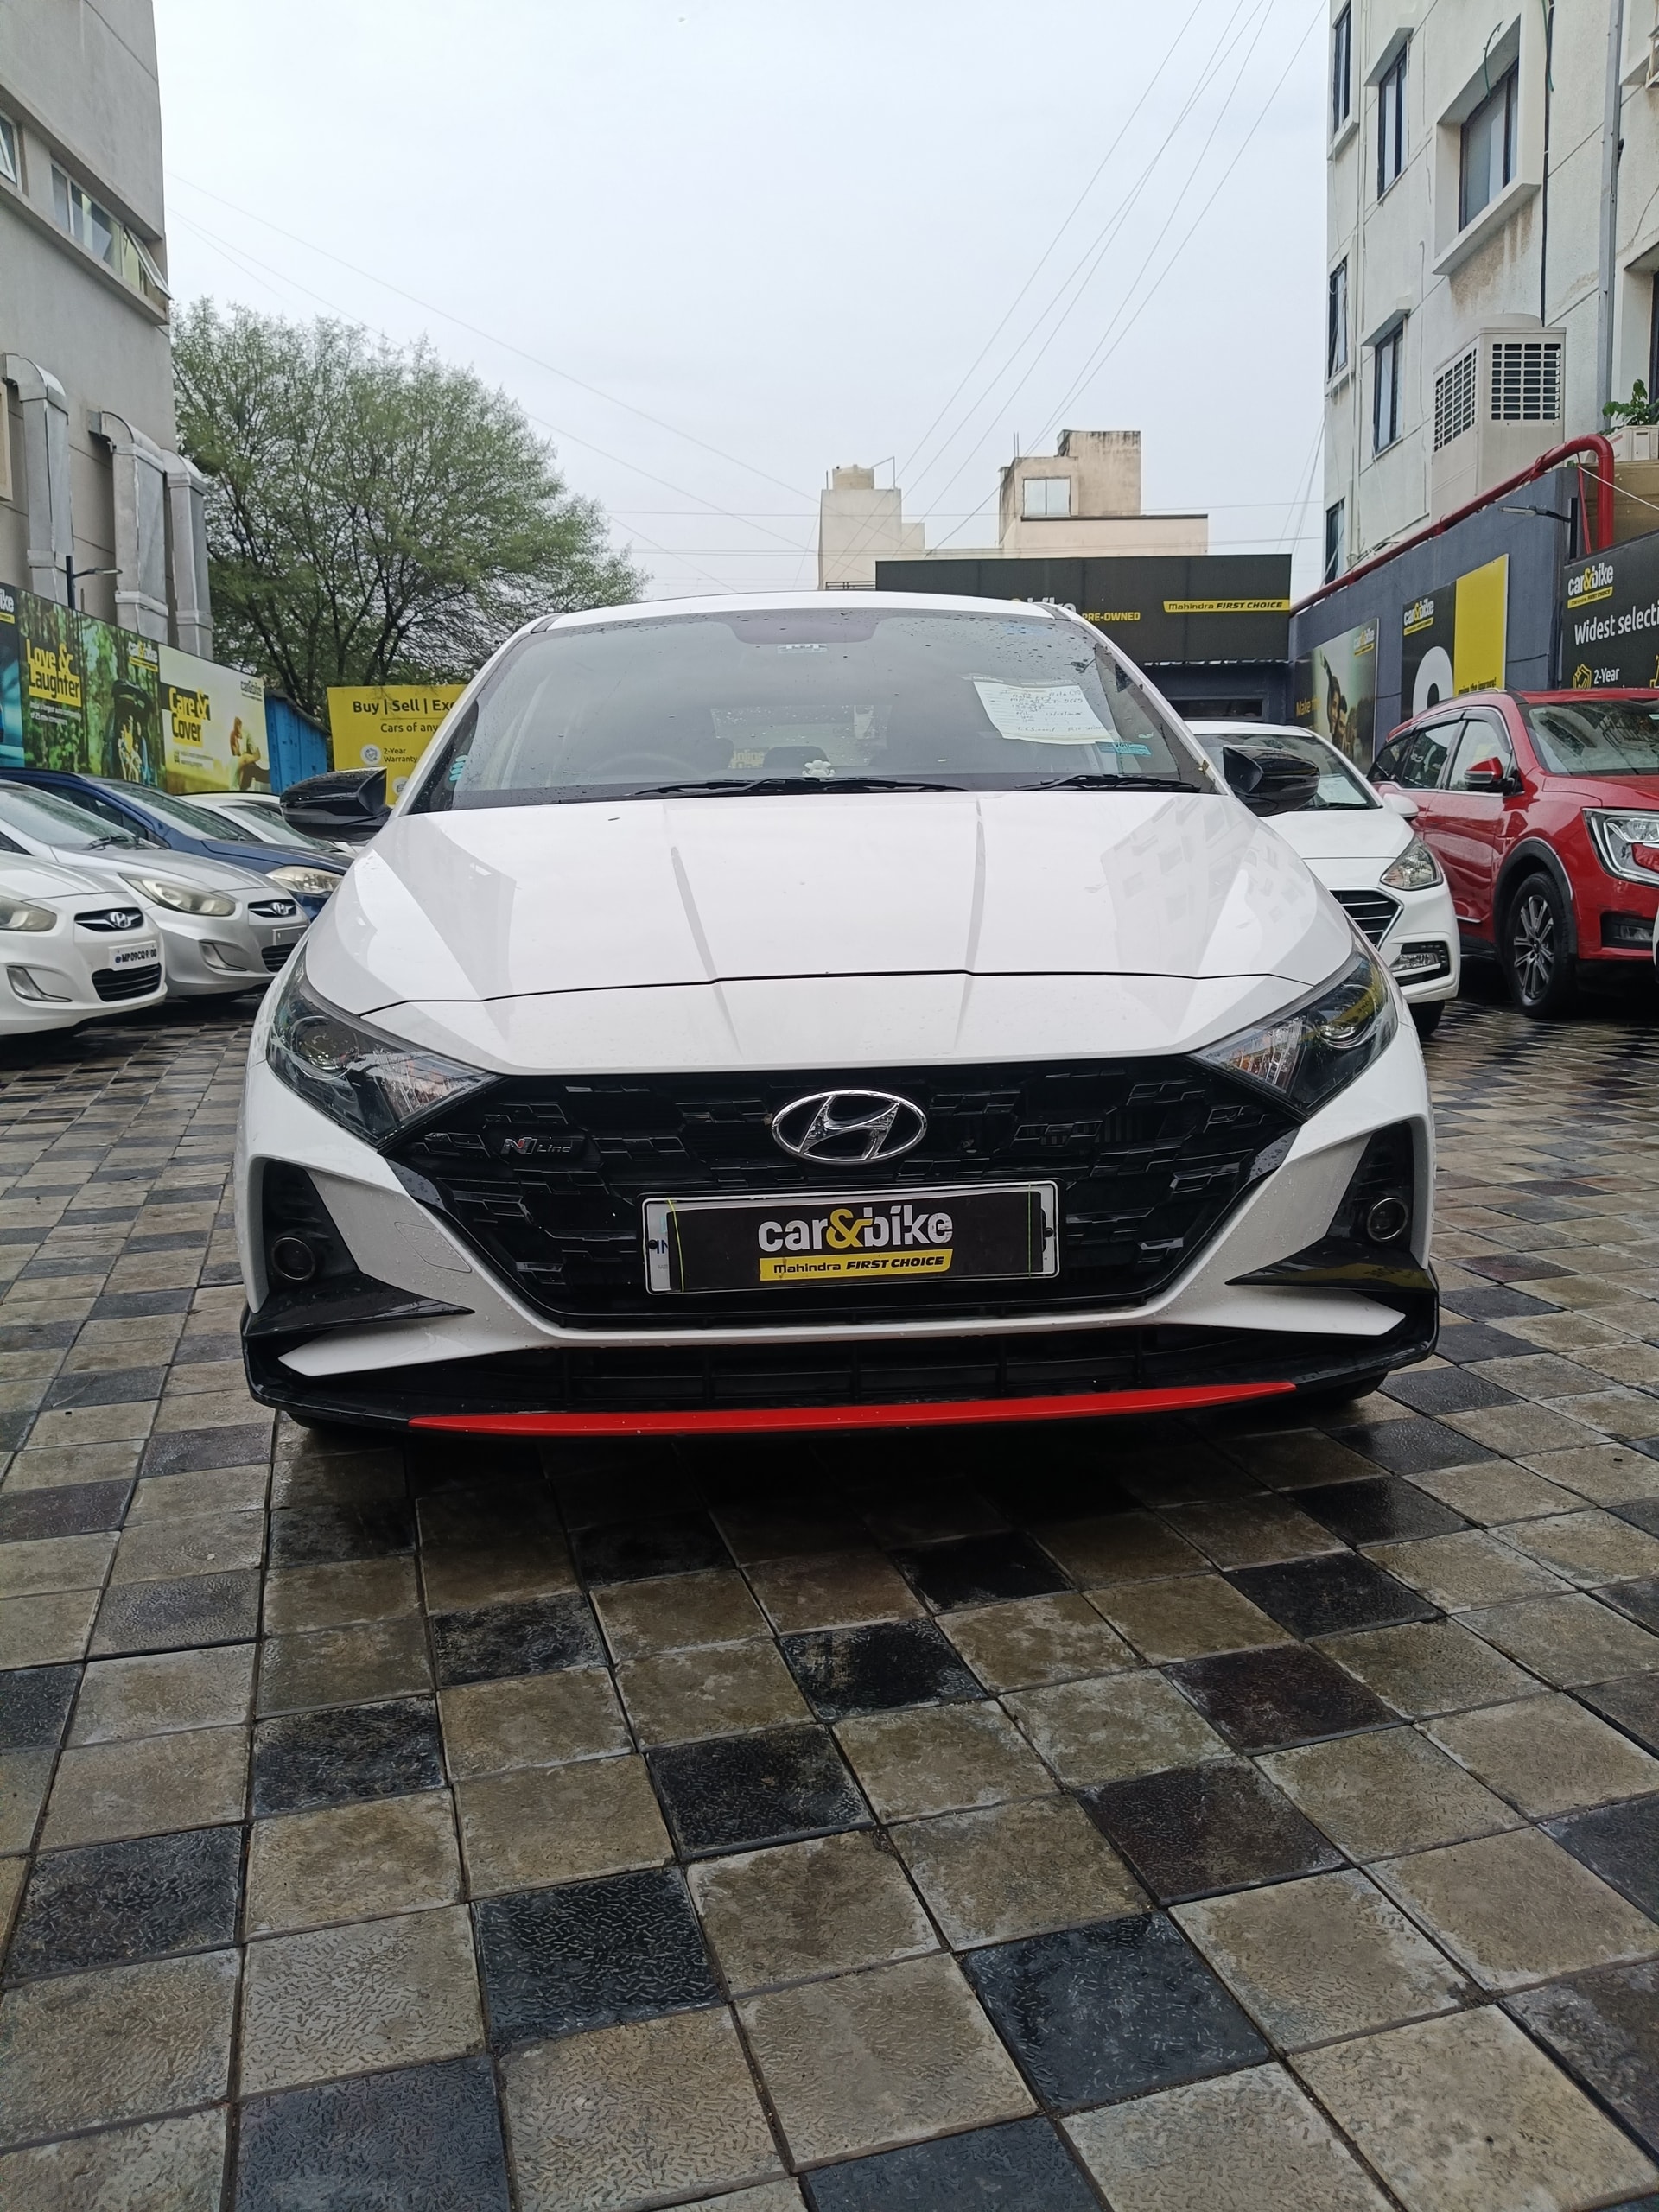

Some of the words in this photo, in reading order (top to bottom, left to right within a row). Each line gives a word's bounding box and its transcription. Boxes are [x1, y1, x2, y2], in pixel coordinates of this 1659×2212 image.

[1568, 562, 1614, 596] car&bike
[1082, 612, 1141, 622] PRE-OWNED
[1574, 614, 1616, 645] Widest
[26, 639, 56, 670] Love
[30, 663, 79, 698] Laughter
[1593, 667, 1620, 685] 2-Year
[169, 687, 195, 717] Care
[353, 701, 379, 715] Buy
[392, 699, 420, 712] Sell
[172, 712, 201, 742] Cover
[380, 723, 404, 733] Cars
[406, 722, 418, 732] of
[420, 724, 439, 734] any
[758, 1205, 953, 1252] car&bike
[773, 1262, 841, 1274] Mahindra
[846, 1259, 889, 1270] FIRST
[891, 1256, 944, 1268] CHOICE
